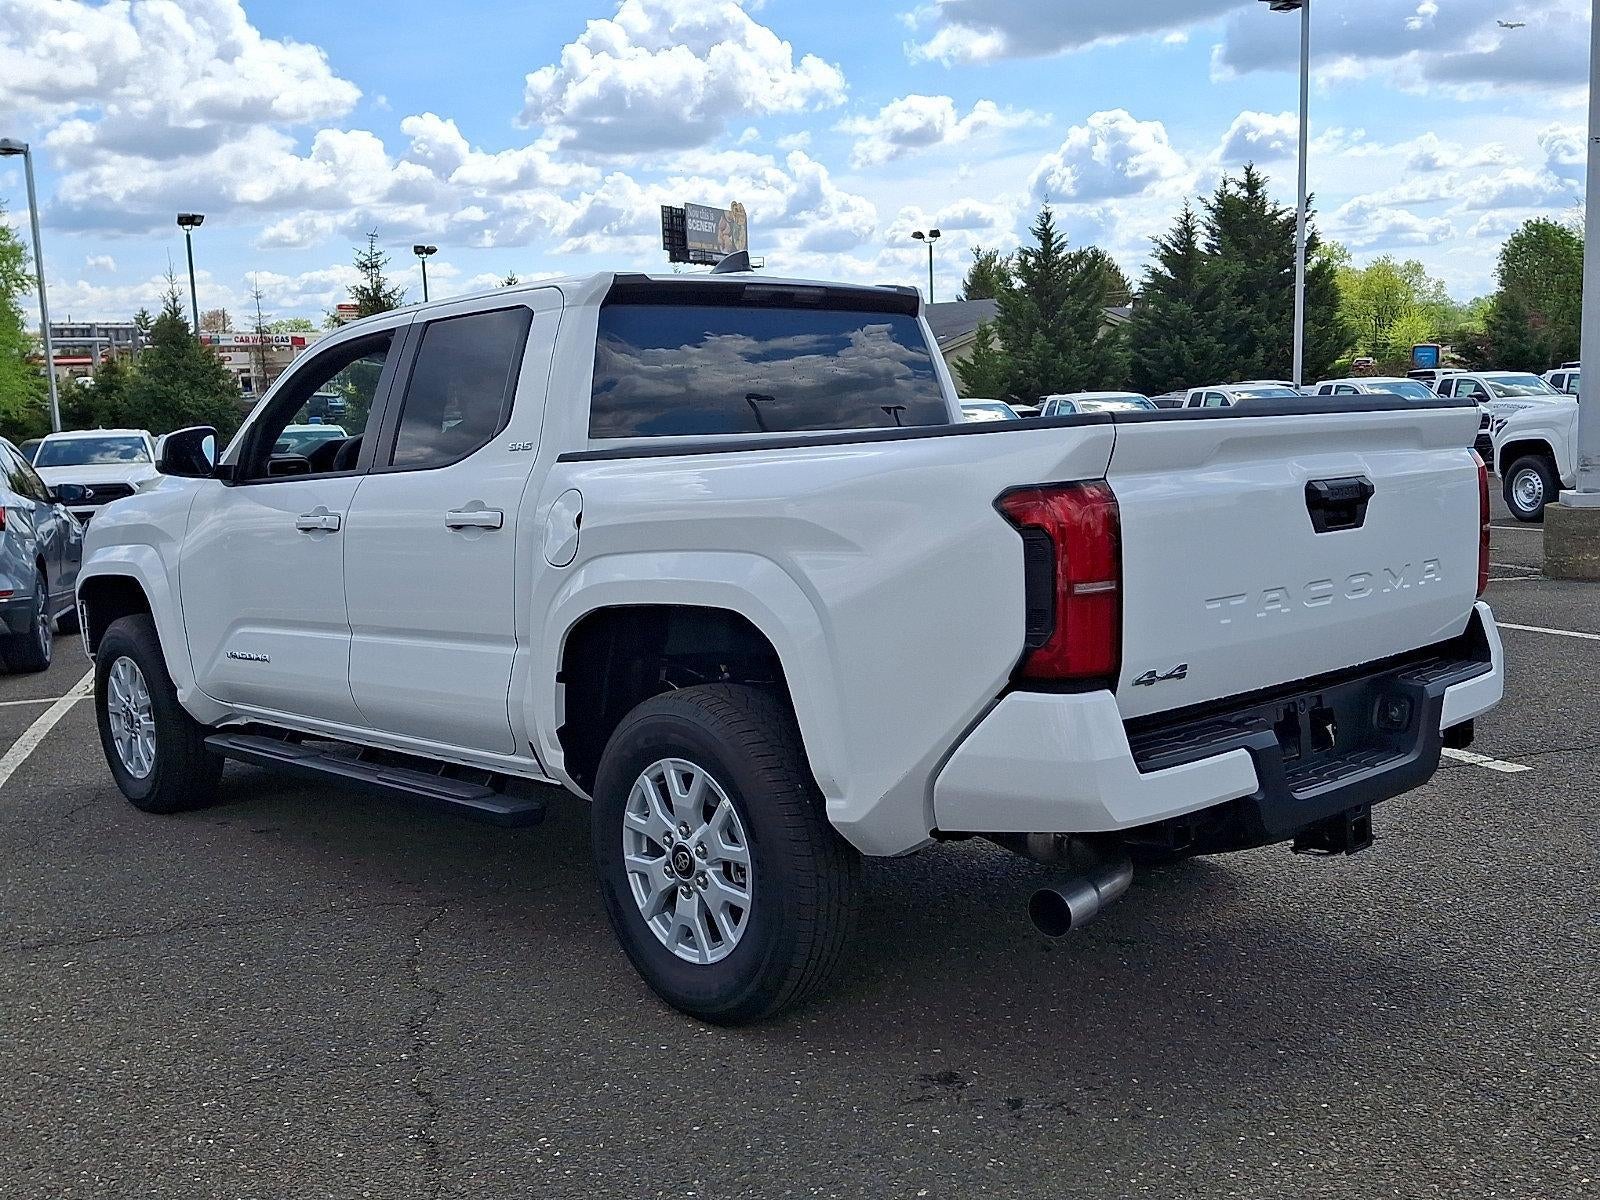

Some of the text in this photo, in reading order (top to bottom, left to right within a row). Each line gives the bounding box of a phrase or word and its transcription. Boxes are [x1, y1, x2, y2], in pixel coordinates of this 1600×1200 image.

[687, 219, 716, 233] SCENERY
[251, 336, 274, 344] WASH
[1204, 558, 1442, 624] TACOMA
